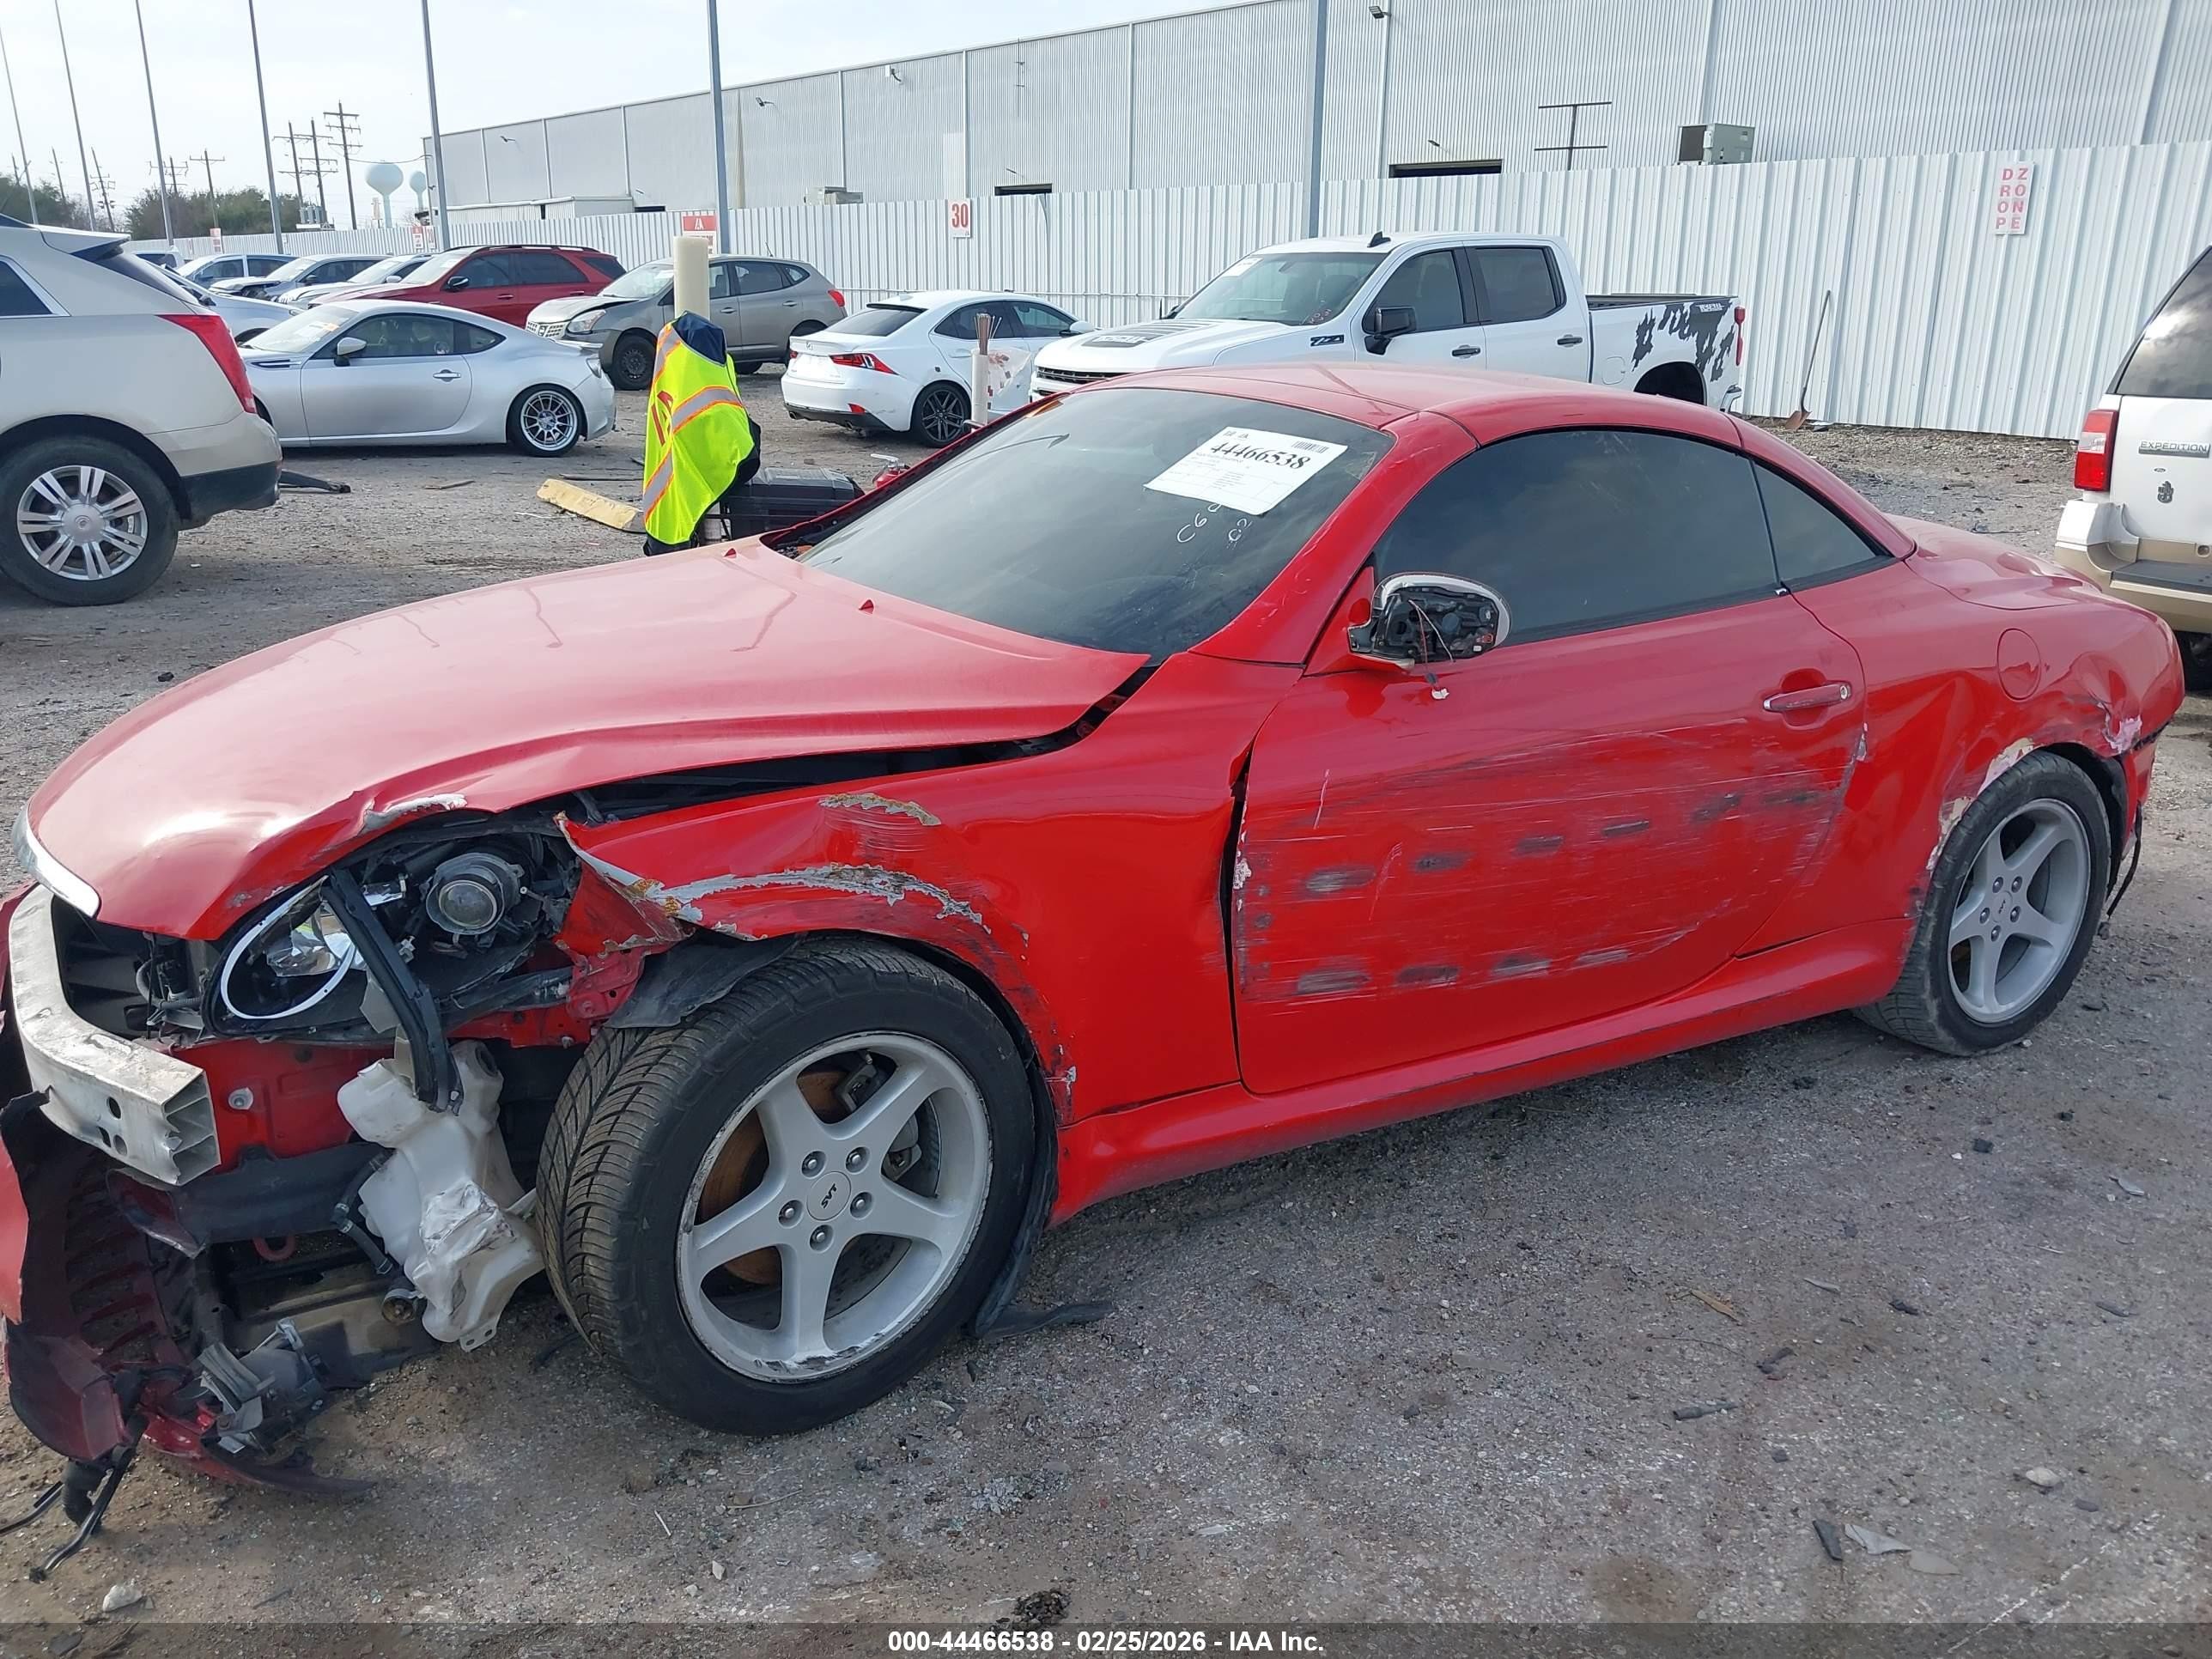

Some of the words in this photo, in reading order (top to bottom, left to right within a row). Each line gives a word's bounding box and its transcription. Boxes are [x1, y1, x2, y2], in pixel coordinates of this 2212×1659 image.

[1996, 168, 2014, 230] DROP
[2010, 167, 2028, 230] ZONE
[951, 203, 969, 228] 30
[1210, 441, 1311, 470] 44466538
[2140, 441, 2208, 453] EXPEDITION
[821, 1182, 837, 1209] SVT
